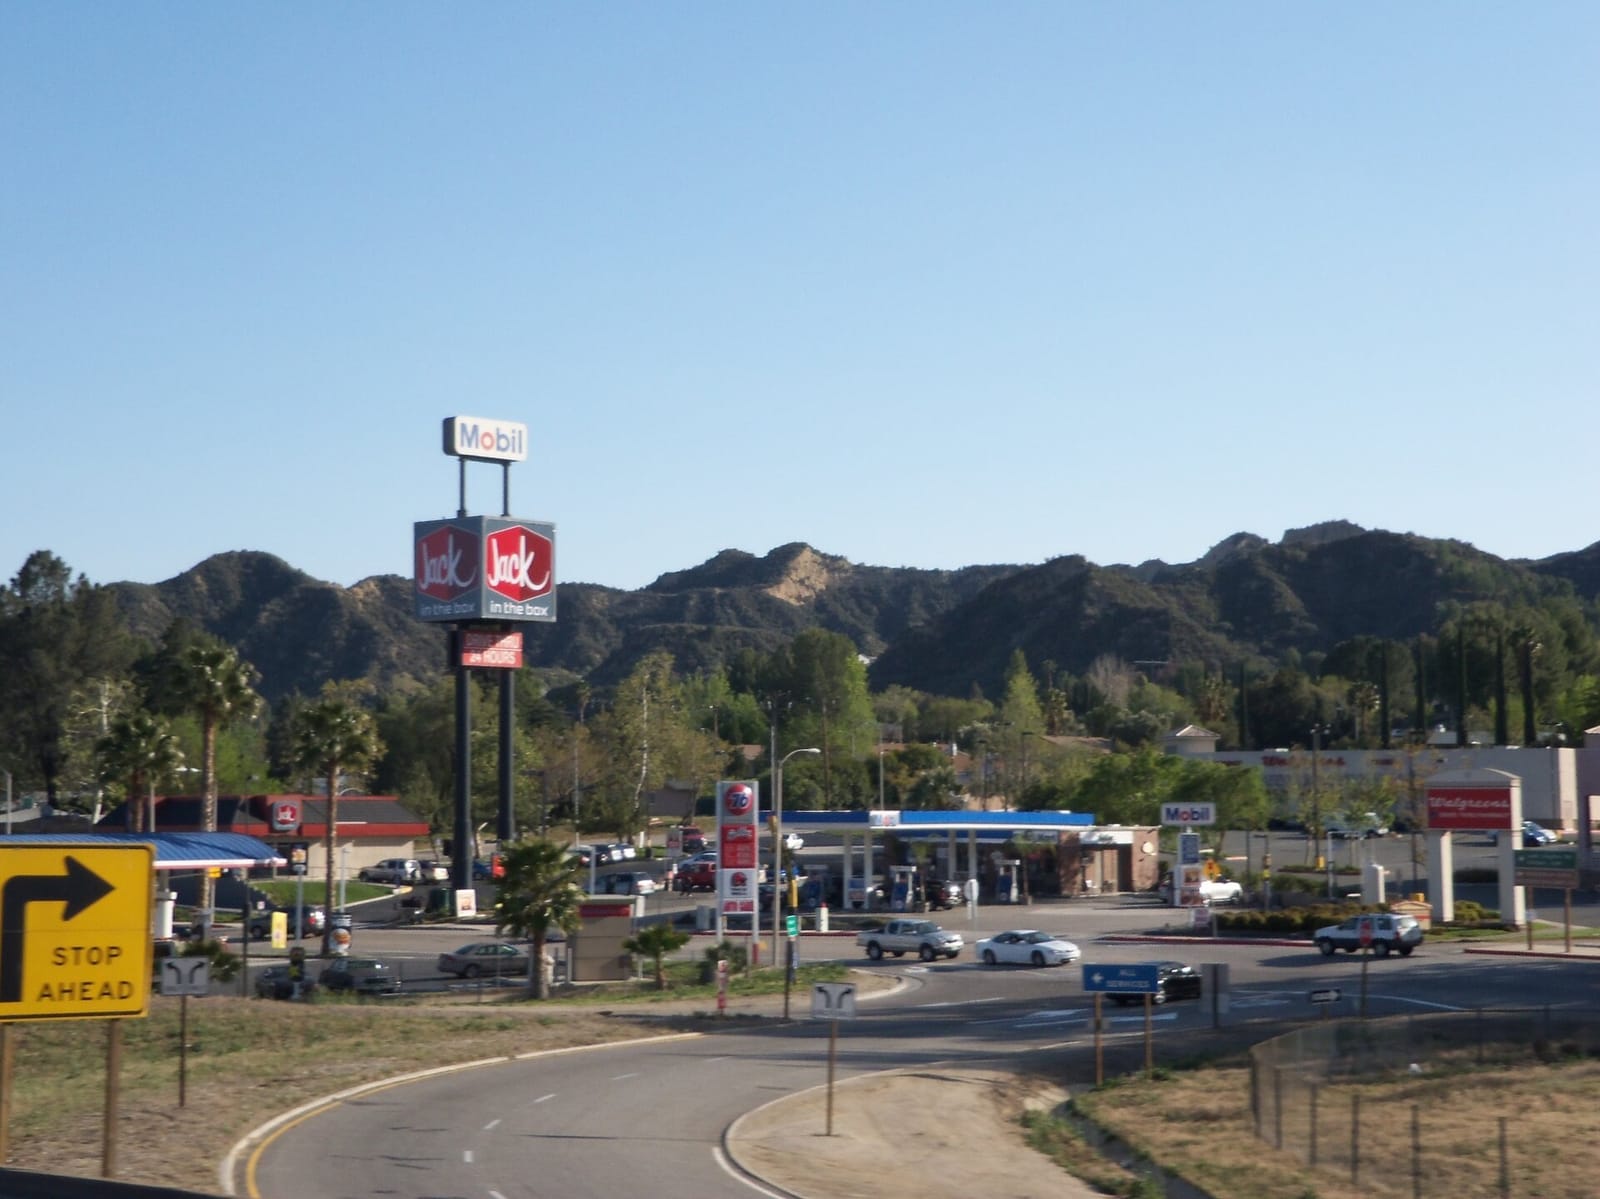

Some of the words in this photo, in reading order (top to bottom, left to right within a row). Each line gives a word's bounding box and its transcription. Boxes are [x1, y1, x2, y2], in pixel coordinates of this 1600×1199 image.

[460, 422, 523, 454] Mobil
[419, 533, 477, 590] Jack
[487, 535, 550, 591] Jack
[420, 604, 431, 616] in
[433, 602, 452, 615] the
[454, 602, 475, 614] box
[490, 601, 500, 614] in
[503, 601, 524, 615] the
[525, 603, 548, 616] box
[730, 792, 750, 808] 76
[1165, 807, 1211, 821] Mobil
[52, 946, 122, 966] STOP
[36, 981, 134, 1002] AHEAD
